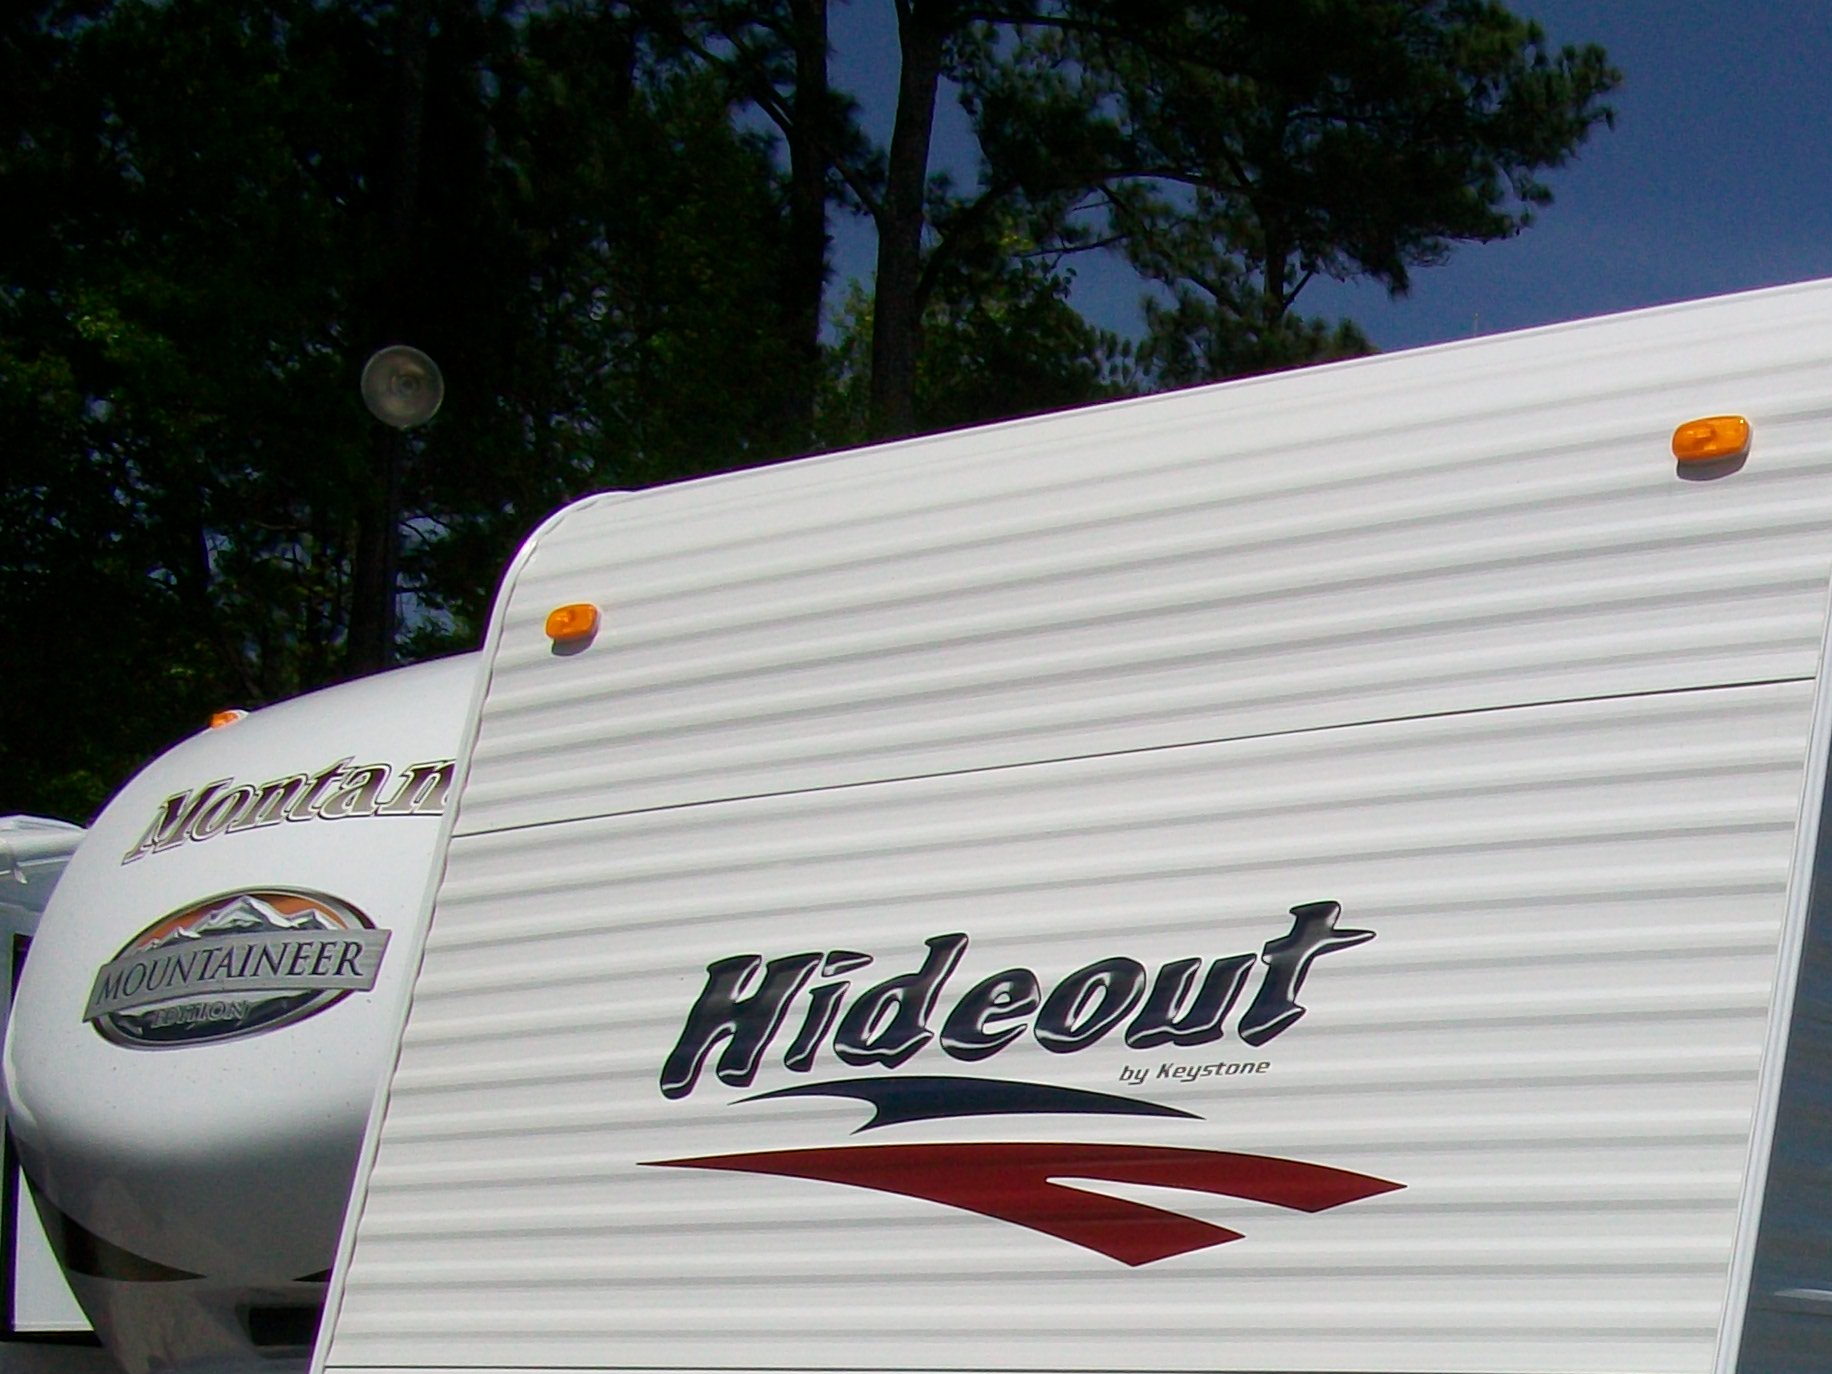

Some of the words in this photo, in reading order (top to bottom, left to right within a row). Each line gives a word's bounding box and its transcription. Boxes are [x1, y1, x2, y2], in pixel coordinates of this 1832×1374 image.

[99, 940, 364, 1002] MOUNTAINEER
[150, 1000, 248, 1028] EDITION
[659, 900, 1377, 1100] Hideout
[1119, 1065, 1149, 1085] by
[1156, 1061, 1271, 1082] Keystone
